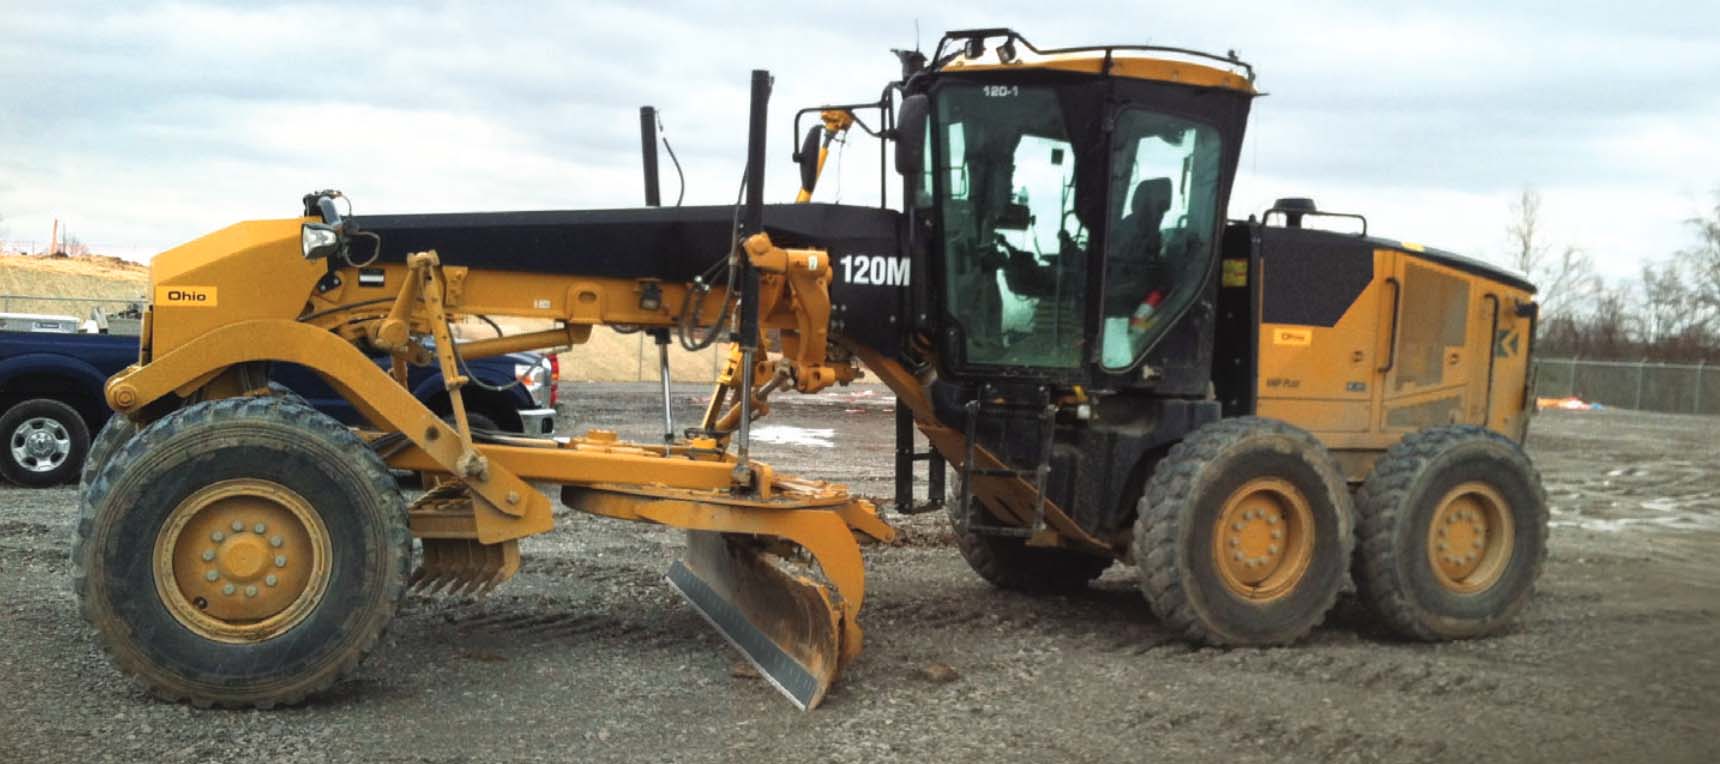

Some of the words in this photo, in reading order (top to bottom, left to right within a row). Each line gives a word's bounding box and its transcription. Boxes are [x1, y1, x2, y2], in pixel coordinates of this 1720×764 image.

[983, 85, 1019, 97] 120-1
[840, 254, 911, 287] 120M
[168, 291, 206, 301] Ohio
